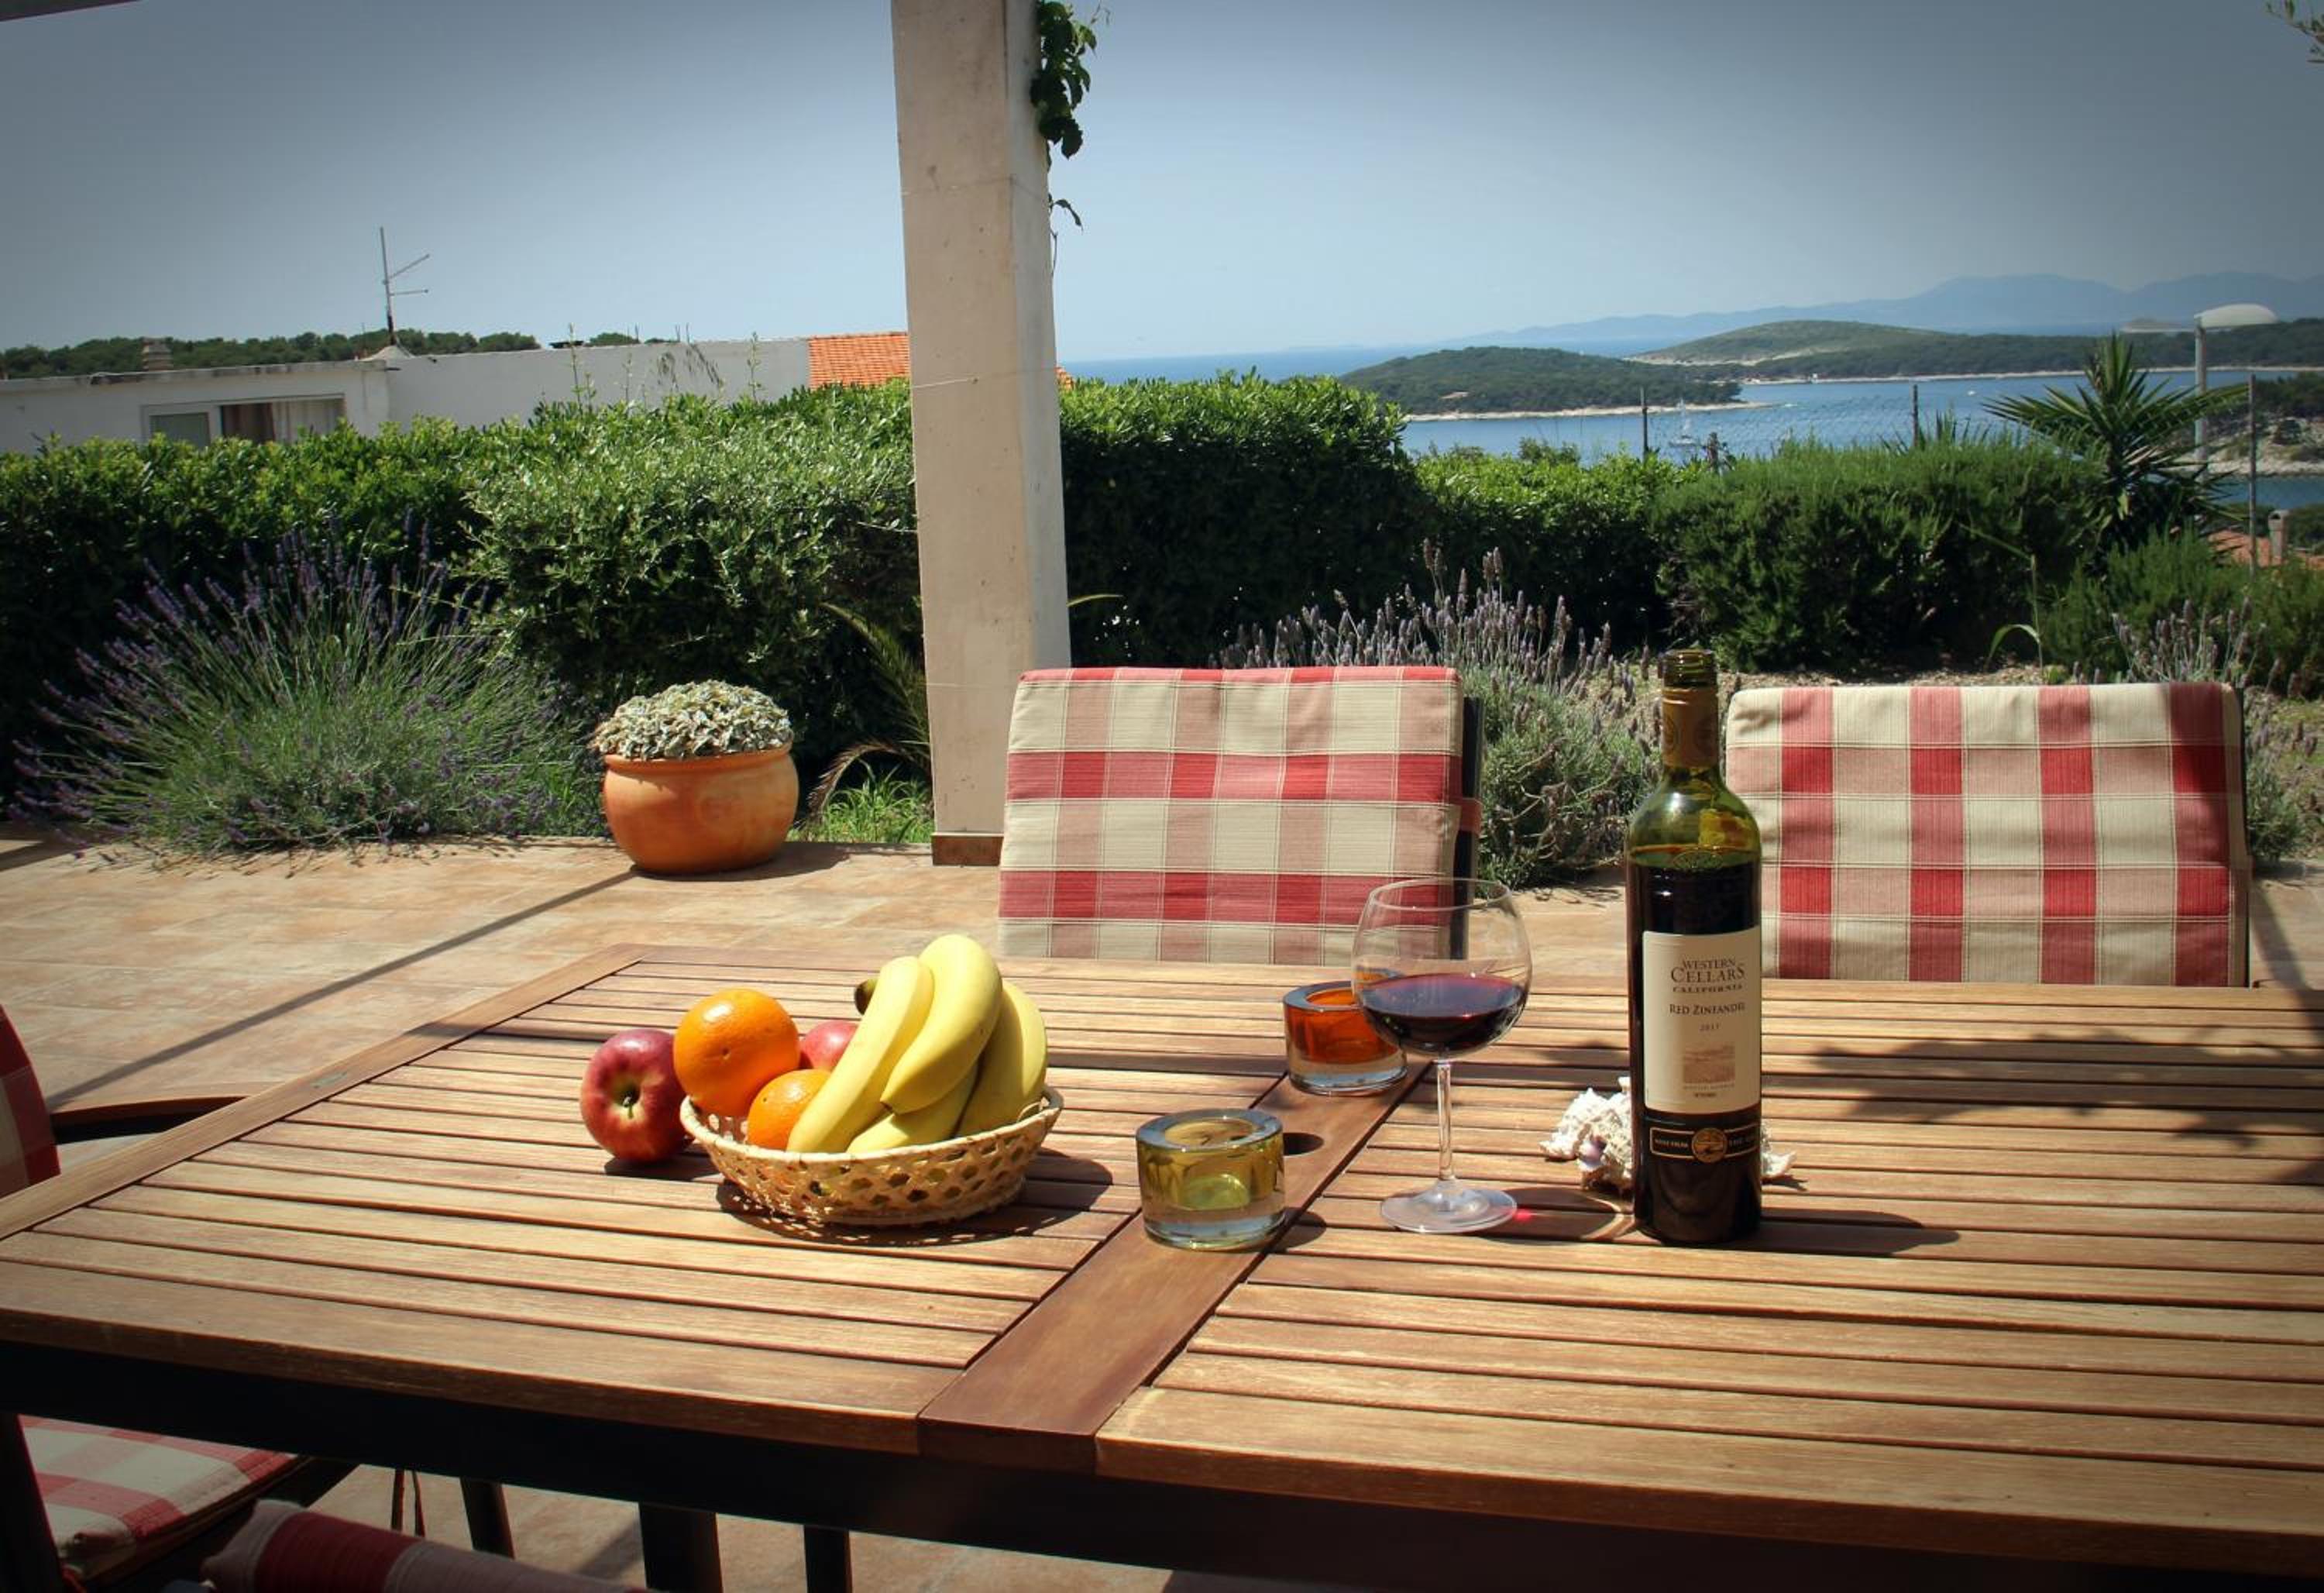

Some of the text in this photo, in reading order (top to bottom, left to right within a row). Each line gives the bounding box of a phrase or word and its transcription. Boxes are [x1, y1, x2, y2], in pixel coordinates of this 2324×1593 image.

[1682, 958, 1735, 969] WESTERN
[1671, 963, 1746, 983] CELLARS
[1673, 984, 1743, 993] CALIFORNIA
[1669, 1003, 1690, 1014] RED
